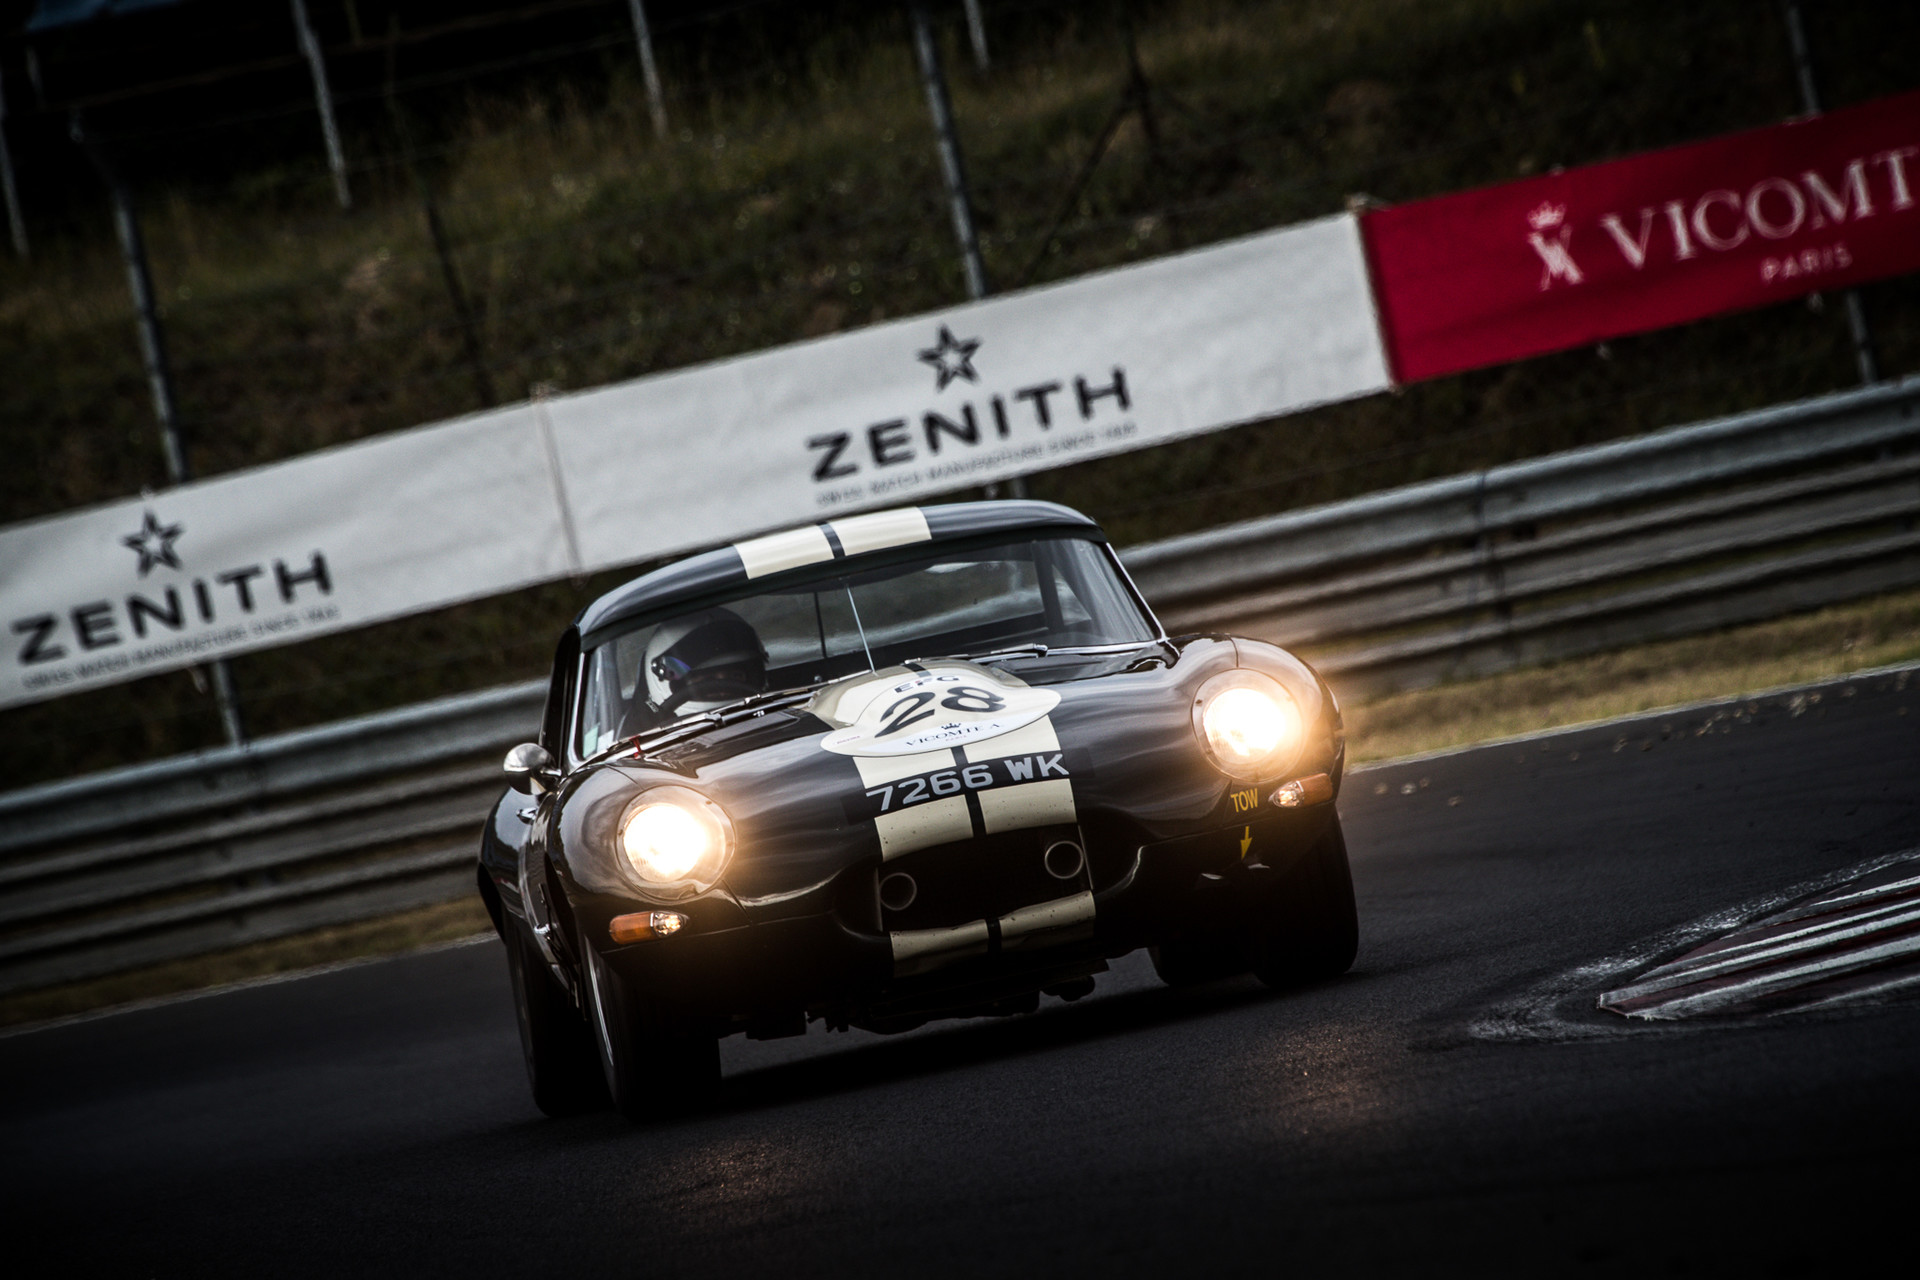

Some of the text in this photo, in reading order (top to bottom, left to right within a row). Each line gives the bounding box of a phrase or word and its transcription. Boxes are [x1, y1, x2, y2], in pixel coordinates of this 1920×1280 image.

[1600, 145, 1920, 270] VICOMT
[1760, 243, 1853, 283] PARIS
[806, 364, 1132, 482] ZENITH
[11, 549, 334, 664] ZENITH
[875, 686, 1006, 737] 28
[906, 727, 983, 746] VICOMTE
[866, 753, 1069, 811] 7266 WK
[1231, 788, 1258, 812] TOW
